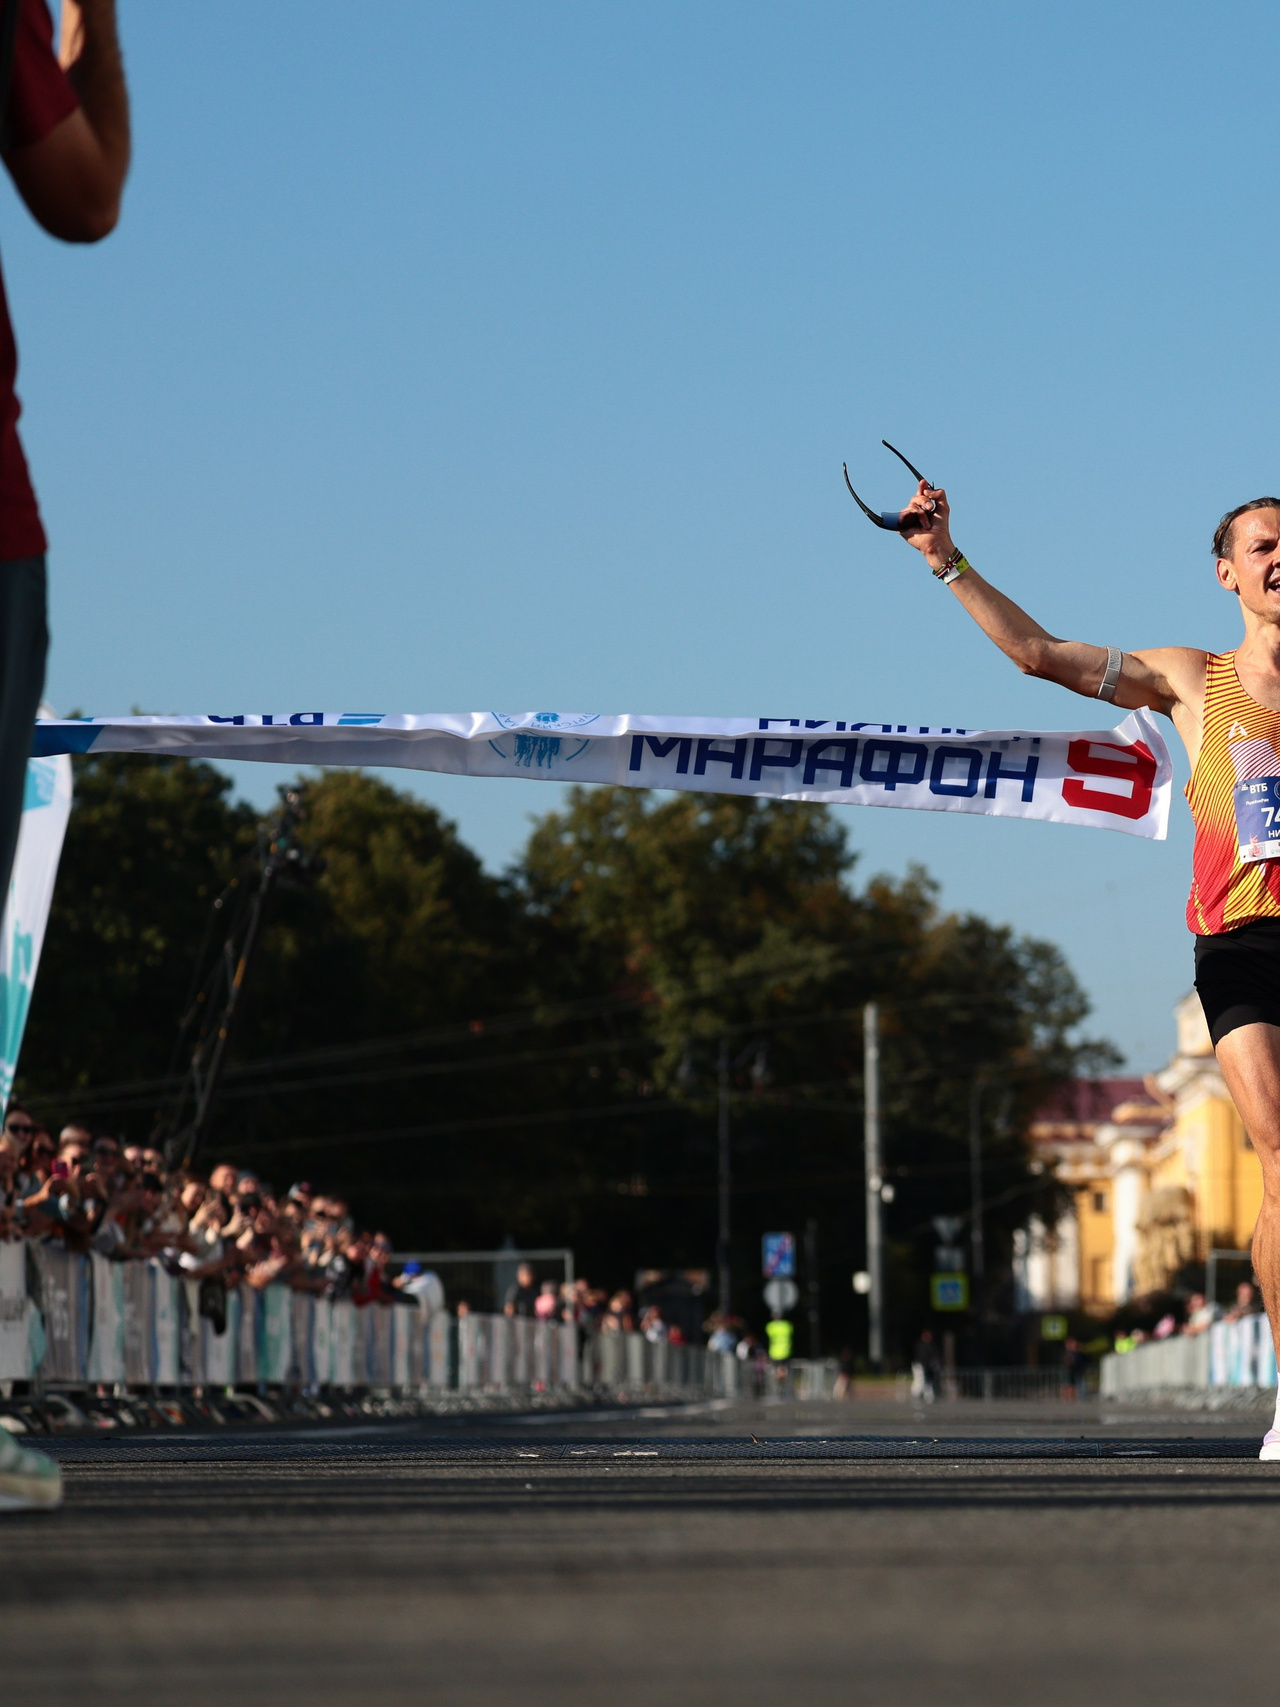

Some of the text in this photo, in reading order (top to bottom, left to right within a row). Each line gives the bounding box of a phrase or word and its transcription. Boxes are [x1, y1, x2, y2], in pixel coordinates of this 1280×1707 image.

[629, 734, 1040, 802] МАРАФОН
[1061, 738, 1157, 820] 9
[1249, 782, 1268, 794] ВТБ
